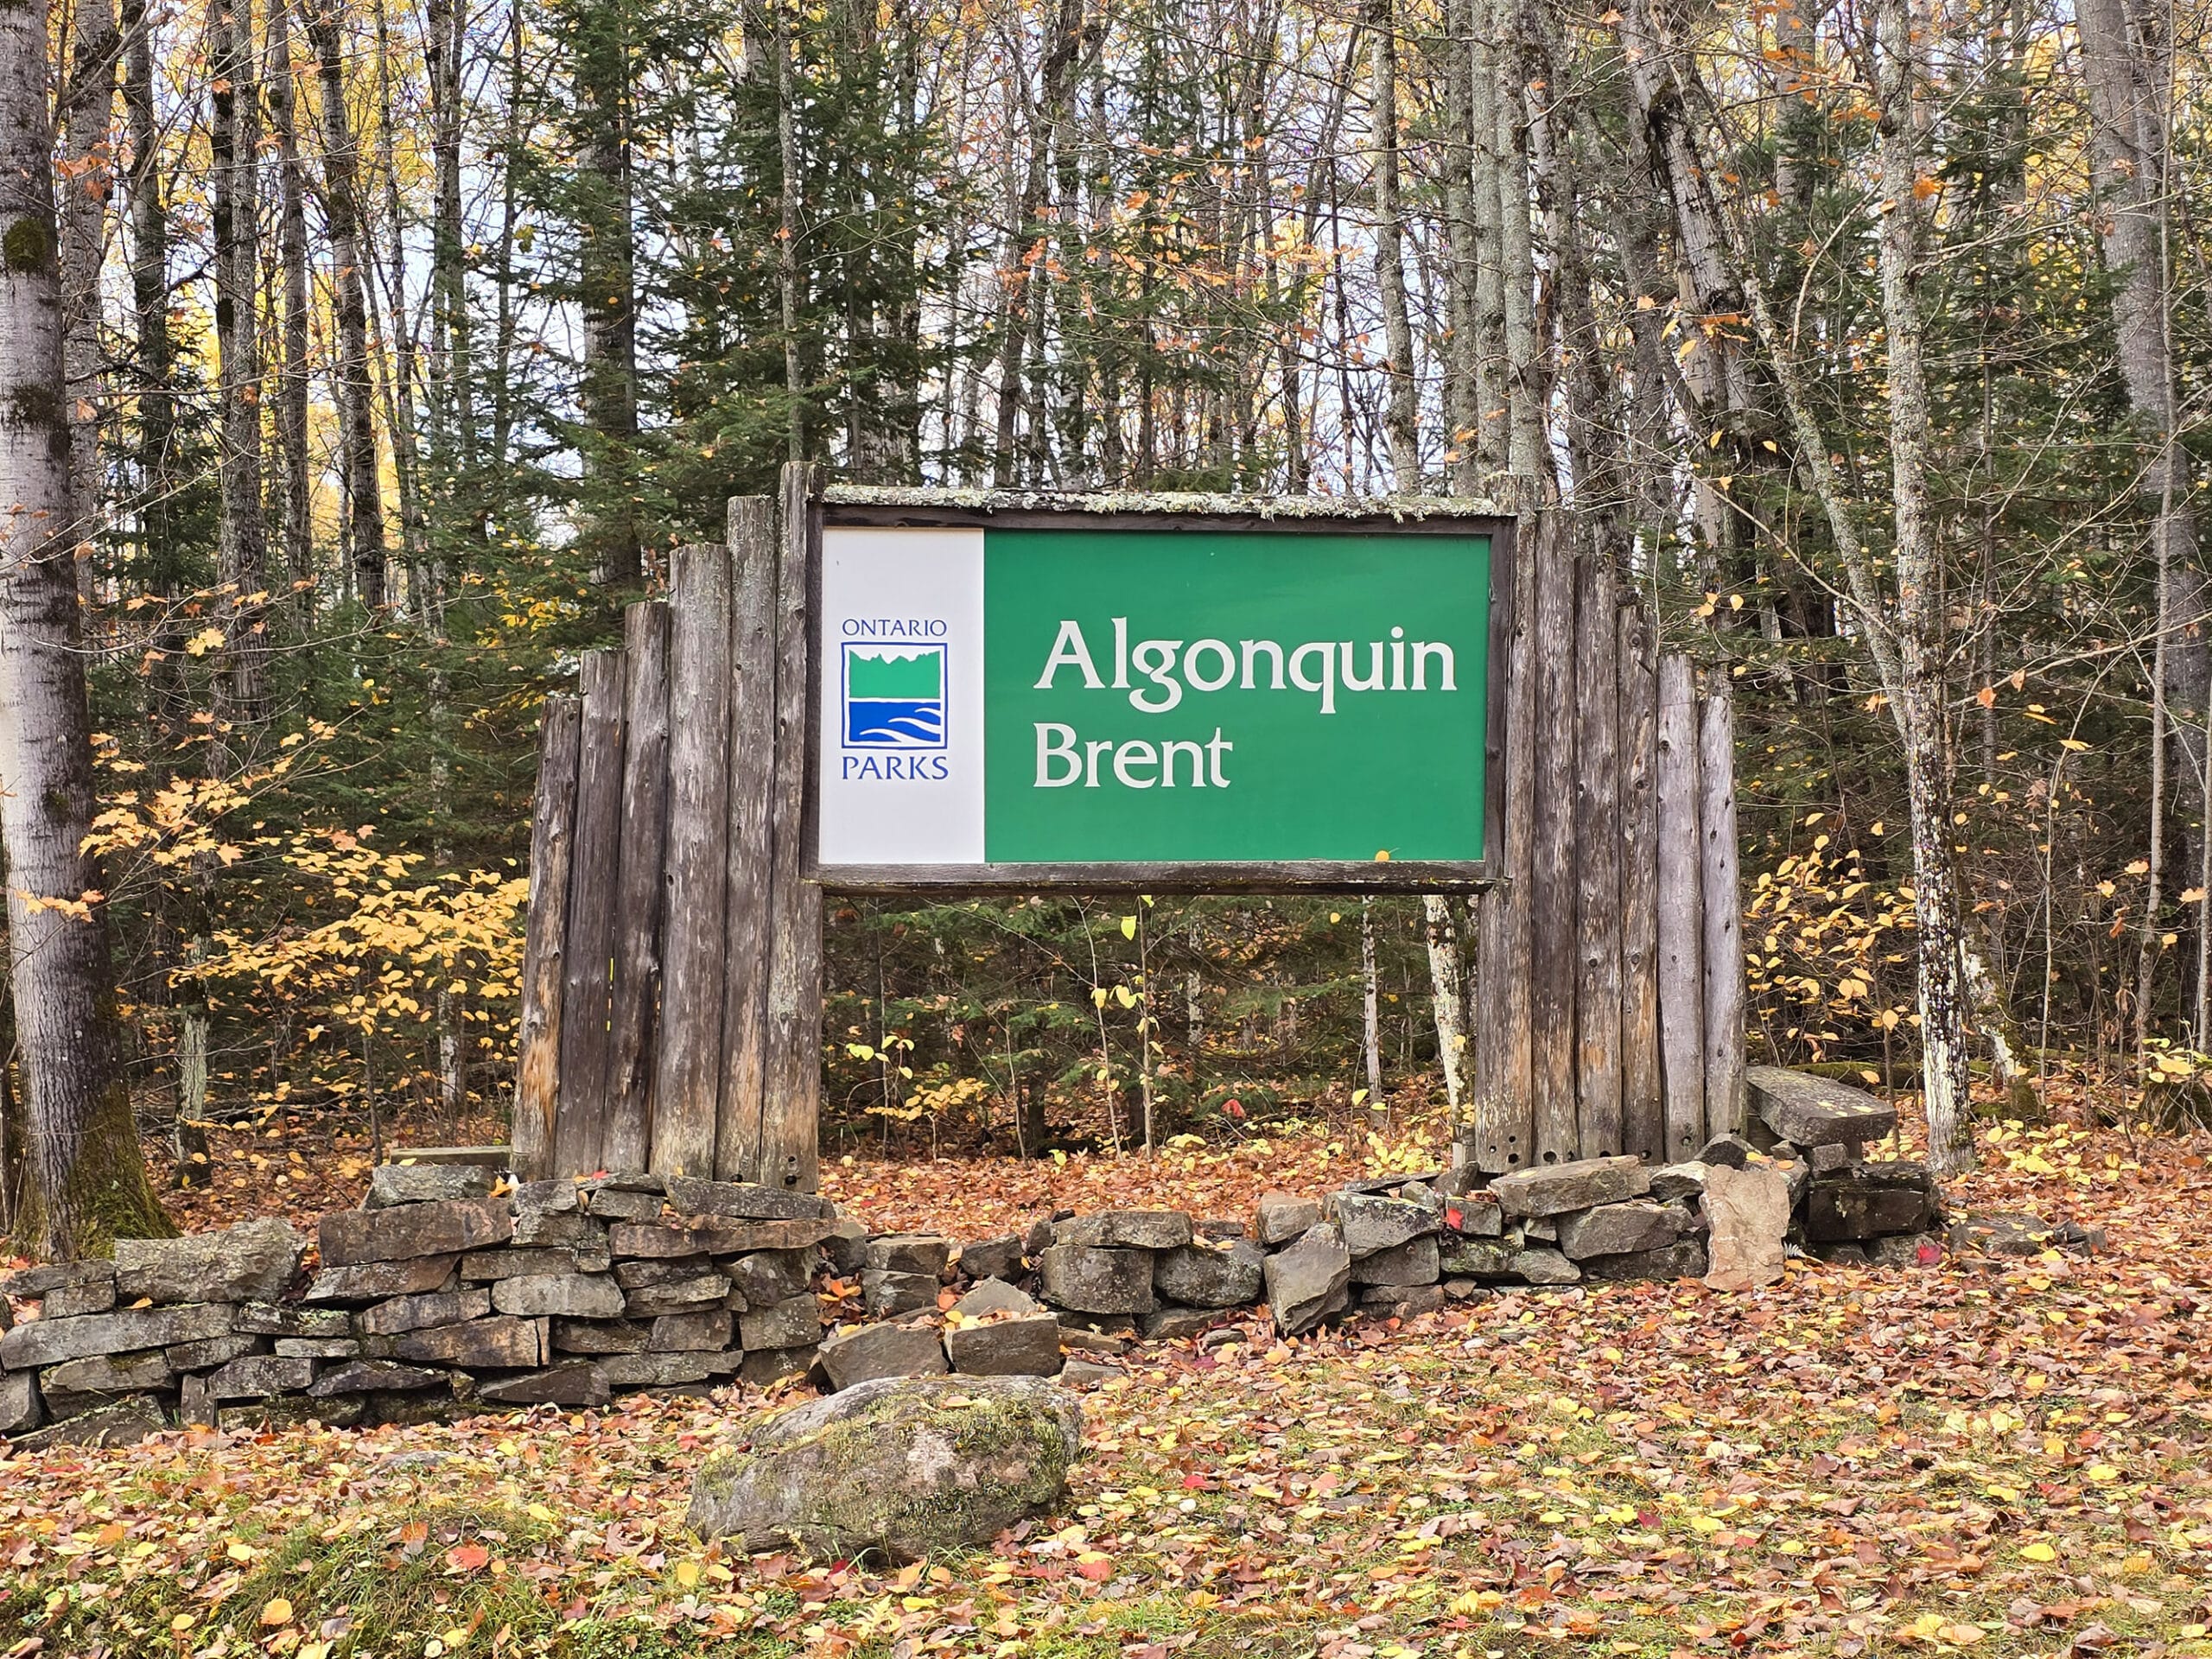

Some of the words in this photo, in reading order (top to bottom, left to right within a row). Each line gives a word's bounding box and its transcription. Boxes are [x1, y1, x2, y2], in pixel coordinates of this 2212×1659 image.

[842, 618, 948, 637] ONTARIO
[1033, 616, 1459, 715] Algonquin
[842, 755, 950, 781] PARKS
[1033, 722, 1235, 789] Brent
